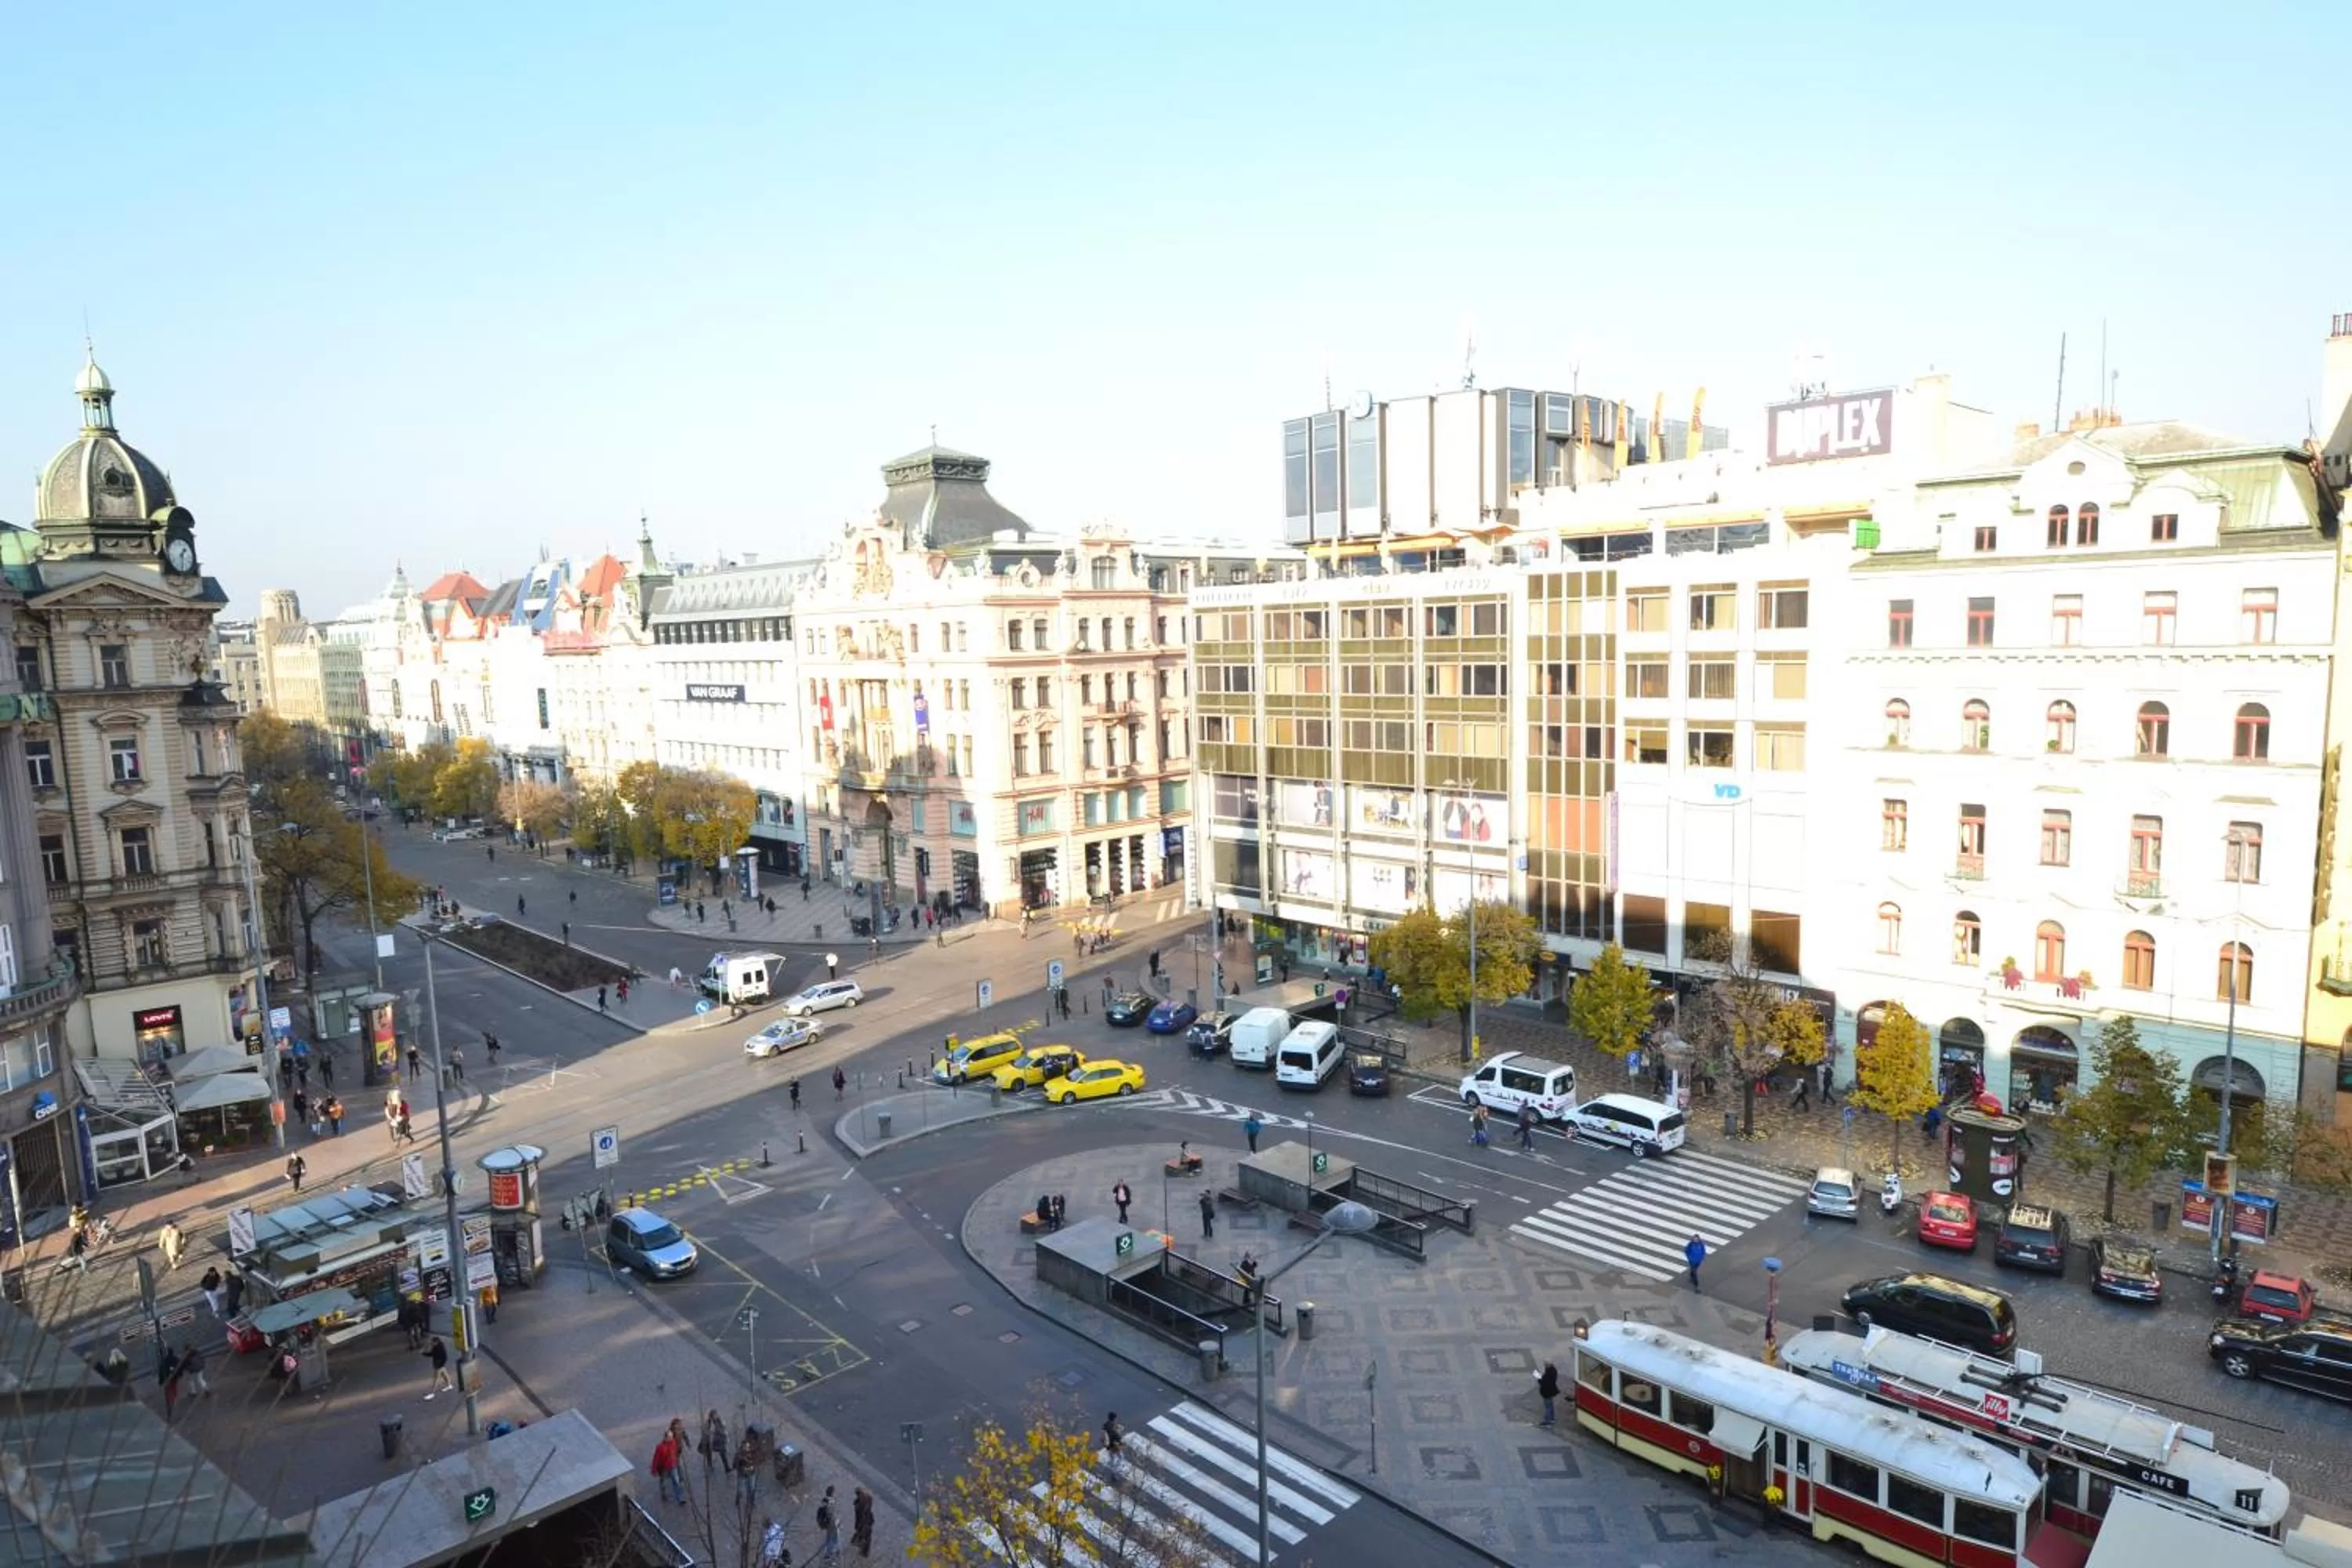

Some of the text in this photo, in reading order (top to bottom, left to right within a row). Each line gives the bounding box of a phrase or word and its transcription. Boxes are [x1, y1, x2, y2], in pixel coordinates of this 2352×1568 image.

[1986, 1396, 2008, 1416] illy
[2141, 1470, 2175, 1489] CAFE
[2241, 1494, 2255, 1510] 11
